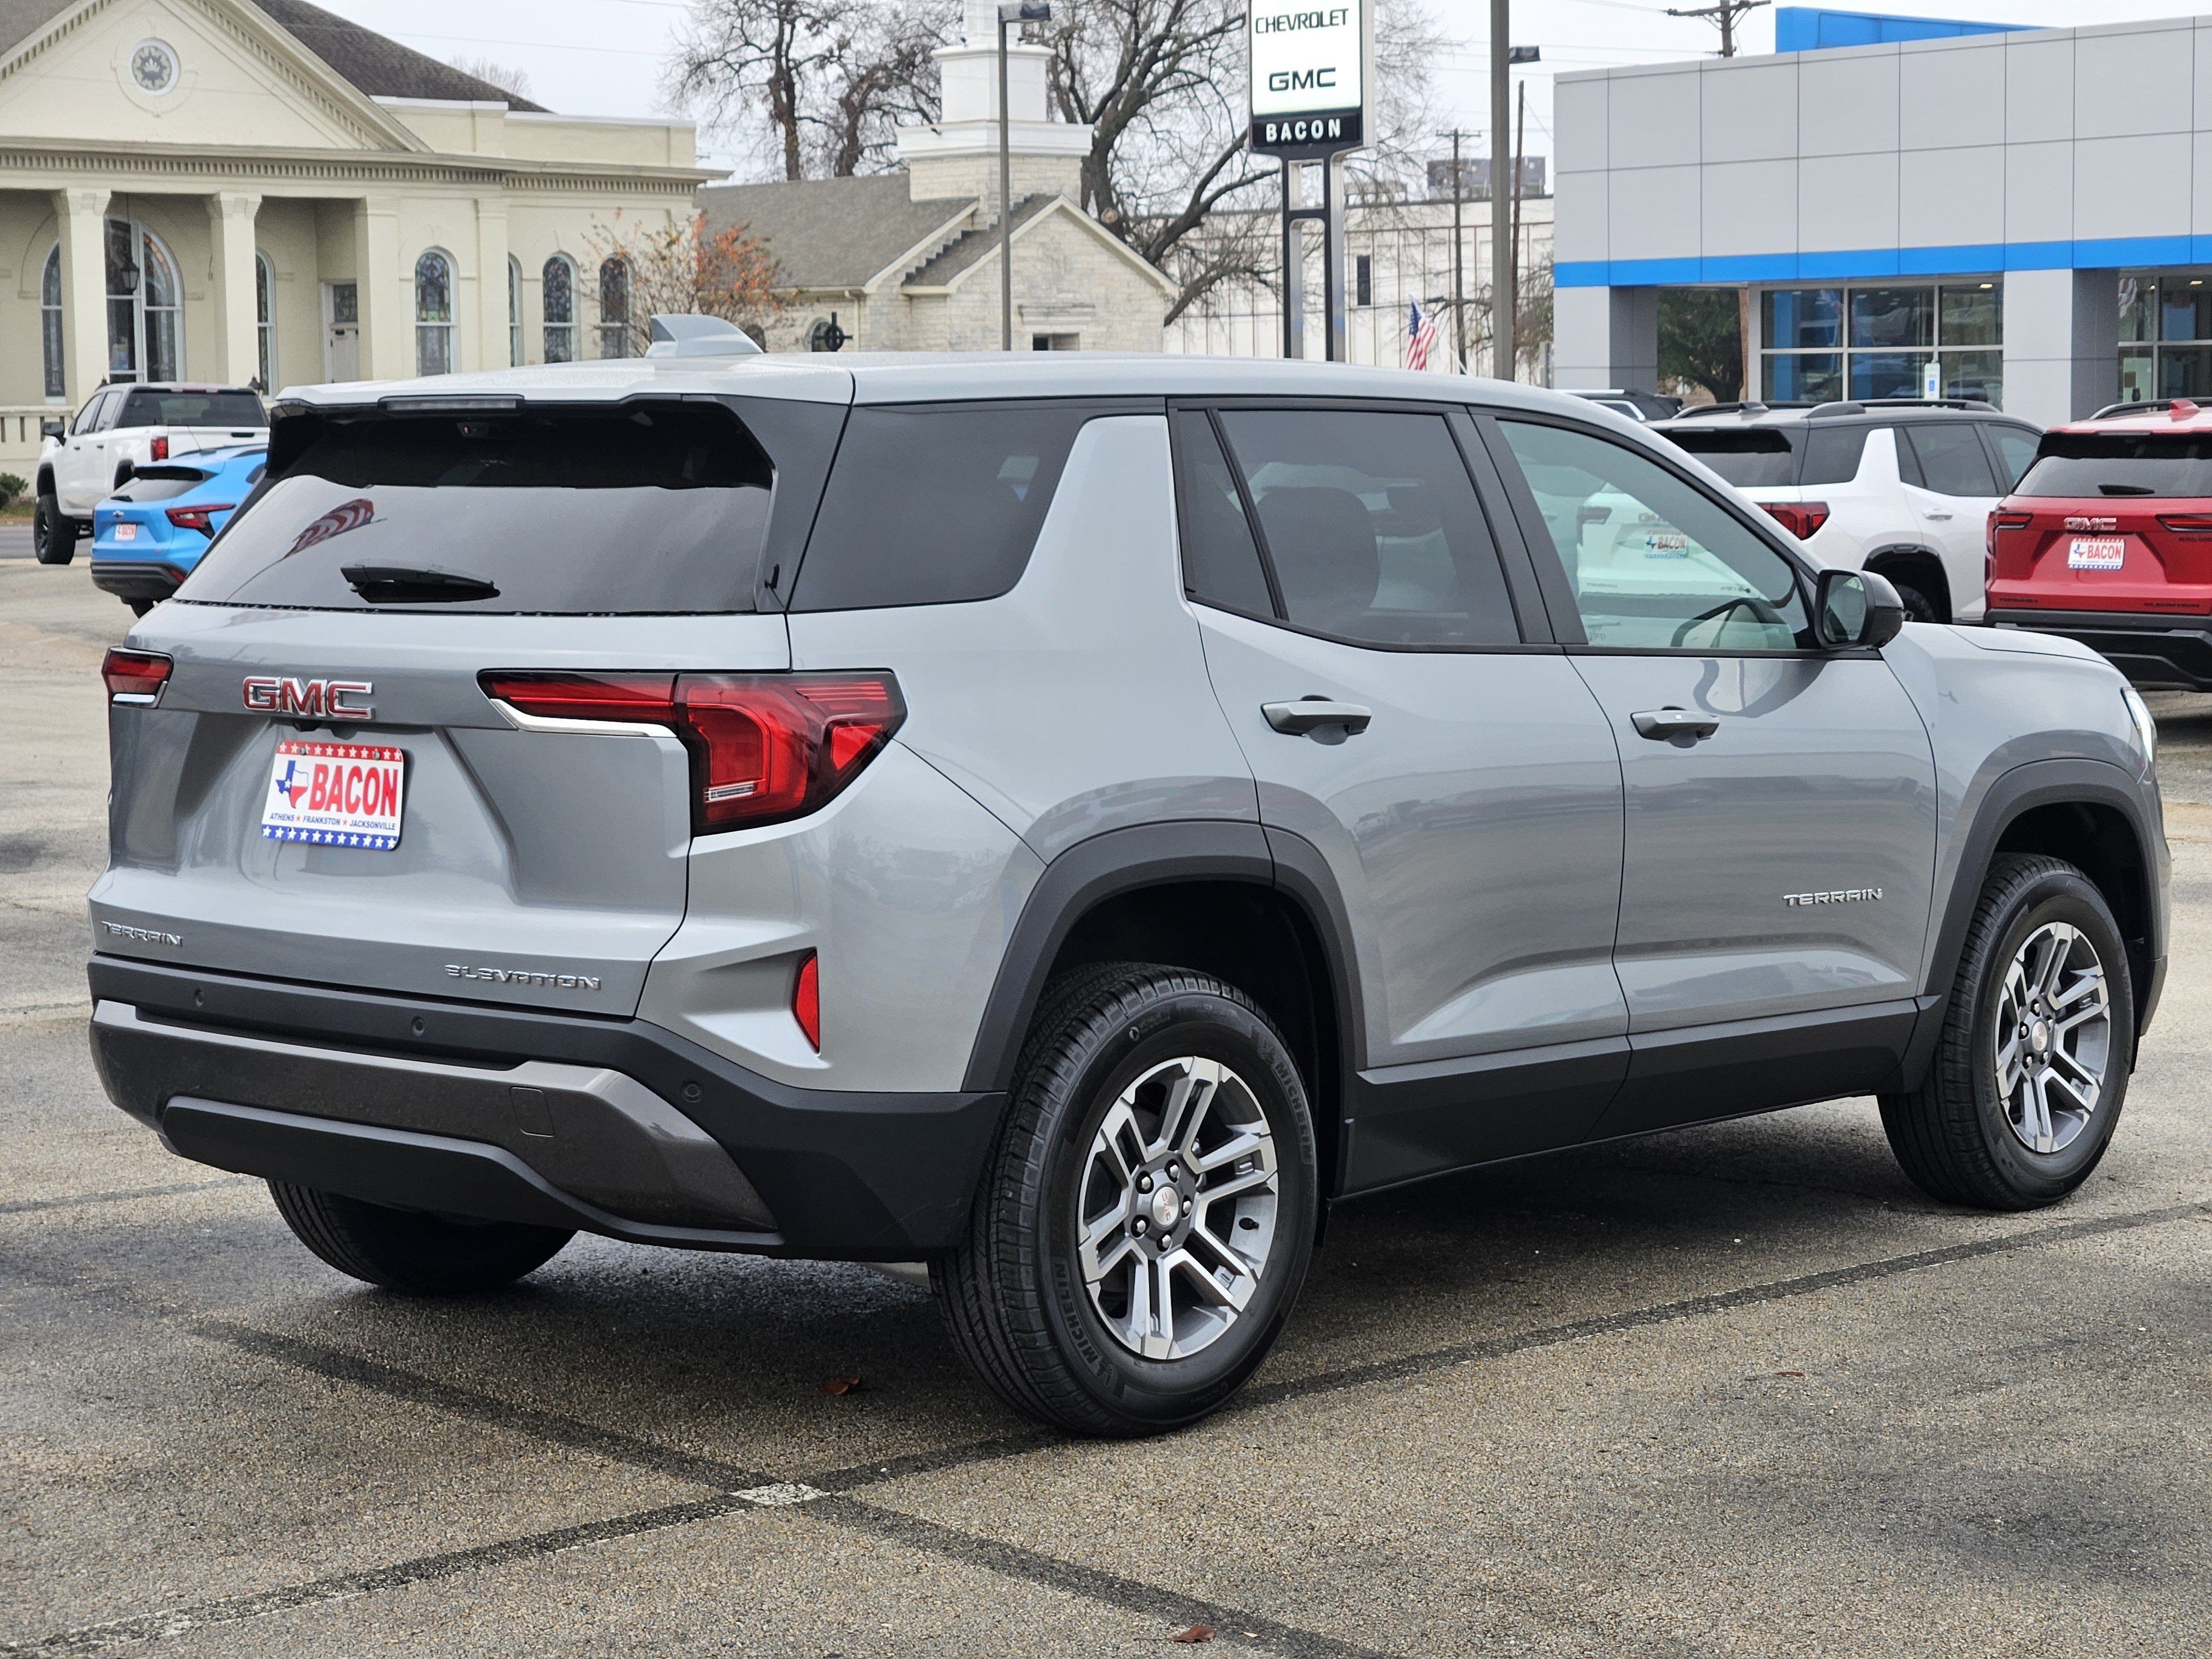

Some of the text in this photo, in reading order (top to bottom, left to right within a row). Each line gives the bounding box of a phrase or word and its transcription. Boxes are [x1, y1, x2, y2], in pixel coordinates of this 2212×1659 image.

[1255, 8, 1349, 34] CHEVROLET
[1269, 67, 1335, 91] GMC
[1266, 118, 1340, 143] BACON
[2064, 517, 2117, 530] GMC
[2087, 545, 2122, 560] BACON
[243, 676, 372, 719] GMC
[308, 764, 399, 817] BACON
[269, 812, 395, 830] ATHENS FRANKSTON JACKSONVILLE
[1783, 888, 1882, 906] TERRAIN
[101, 921, 182, 946] TERRAIN
[445, 964, 601, 989] ELEVATION
[1275, 1061, 1313, 1164] MICHELIN
[1054, 1261, 1100, 1365] MICHELIN
